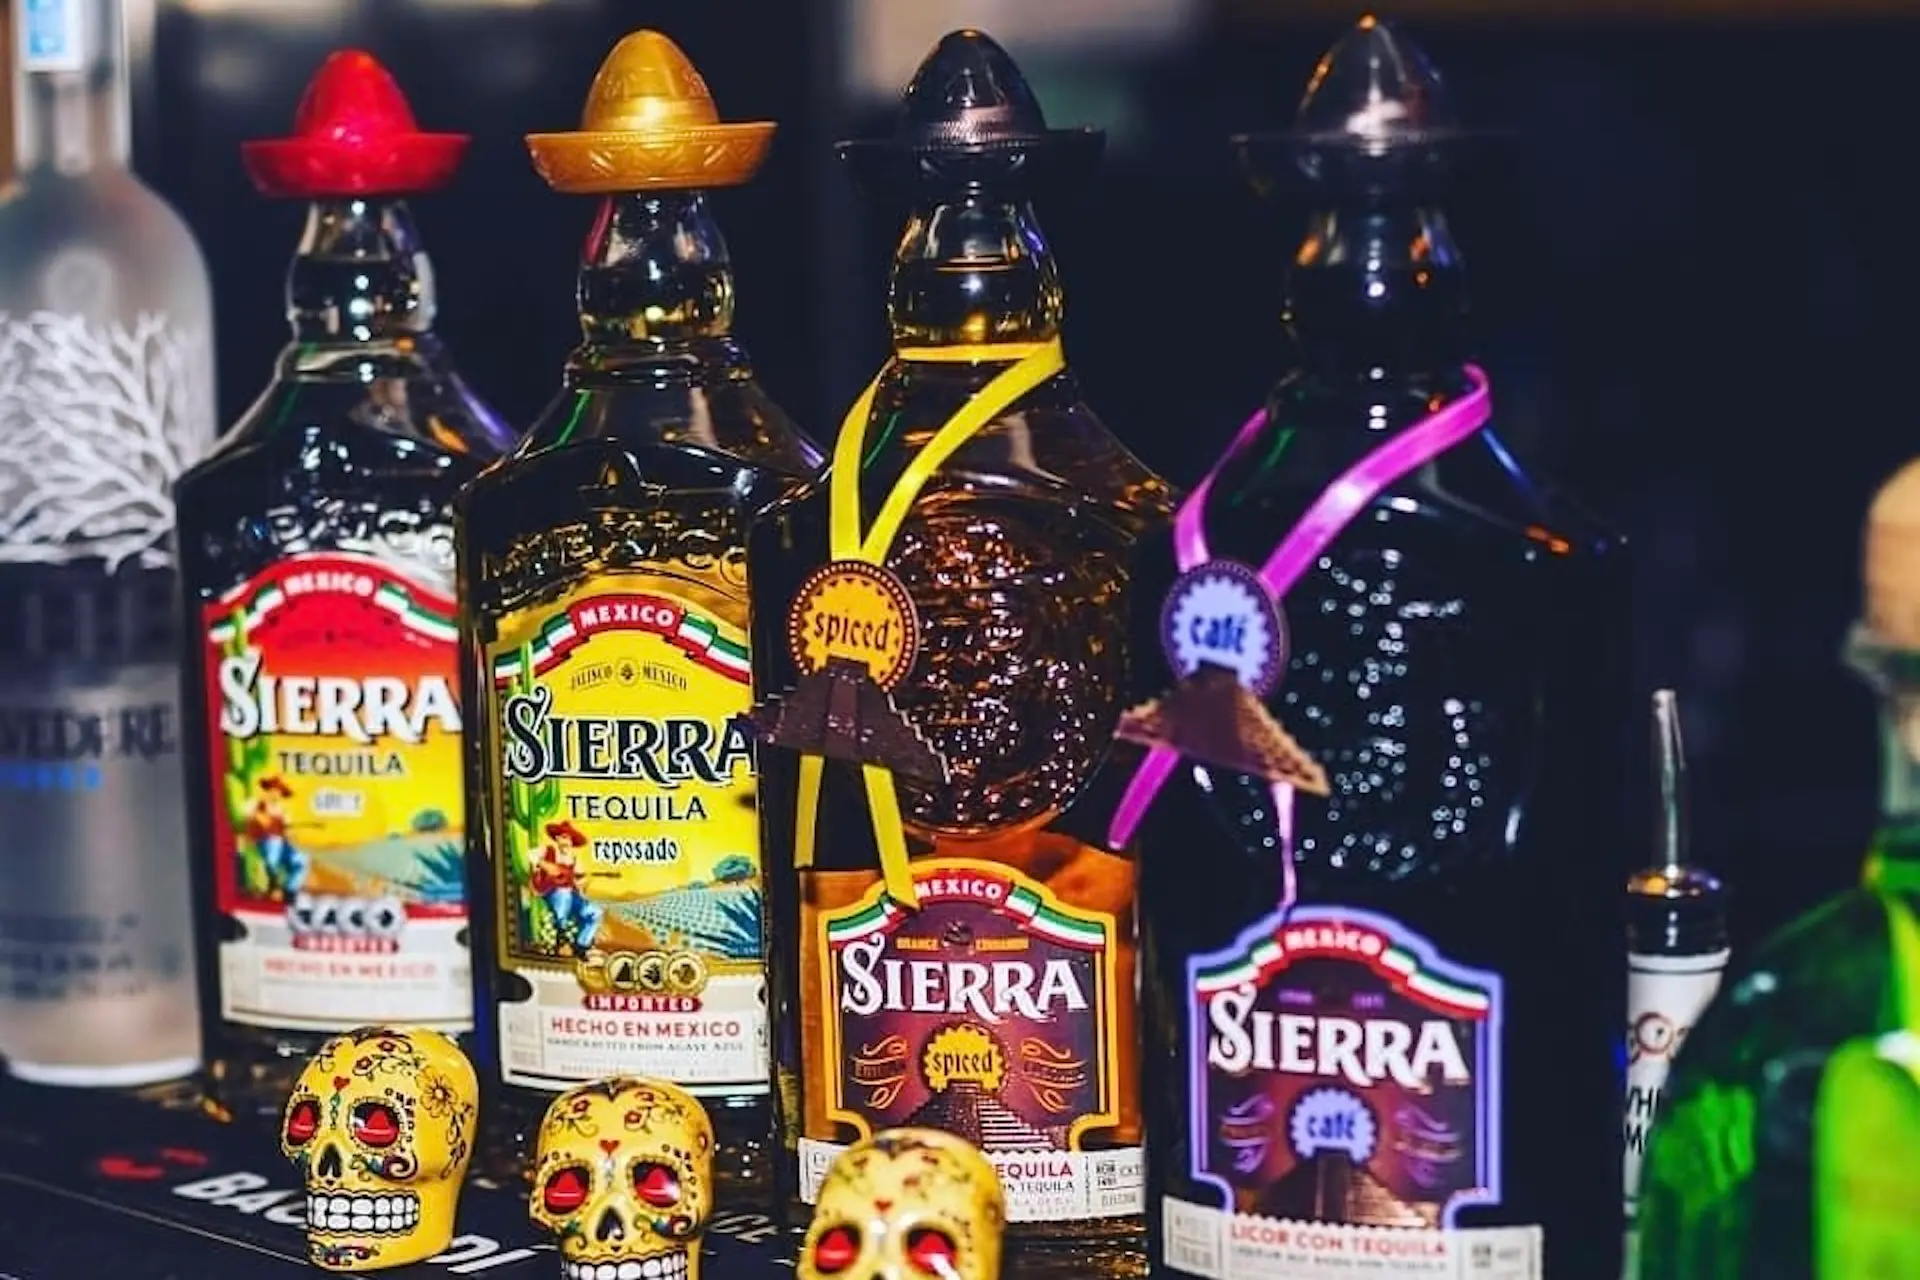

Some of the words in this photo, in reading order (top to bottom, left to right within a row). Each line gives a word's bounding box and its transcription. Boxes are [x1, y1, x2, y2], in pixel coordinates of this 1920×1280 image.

[283, 571, 376, 598] MEXICO
[577, 601, 676, 629] MEXICO
[813, 612, 889, 653] spiced
[1190, 613, 1247, 655] café
[218, 644, 464, 747] SIERRA
[503, 686, 758, 789] SIERRA
[279, 750, 404, 775] TEQUILA
[566, 795, 708, 821] TEQUILA
[593, 838, 678, 863] reposado
[912, 878, 1003, 901] MEXICO
[1283, 928, 1383, 957] MEXICO
[841, 931, 1089, 1024] SIERRA
[588, 995, 695, 1012] IMPORTED
[552, 1017, 618, 1036] HECHO
[624, 1021, 650, 1036] EN
[655, 1021, 741, 1037] MEXICO
[1208, 981, 1470, 1095] SIERRA
[932, 1052, 993, 1077] spiced
[1304, 1113, 1357, 1141] café
[994, 1161, 1073, 1180] EQUILA
[1020, 1182, 1074, 1194] TEQUILA
[1230, 1224, 1288, 1245] LICOR
[1296, 1234, 1342, 1250] CON
[1352, 1238, 1447, 1256] TEQUILA
